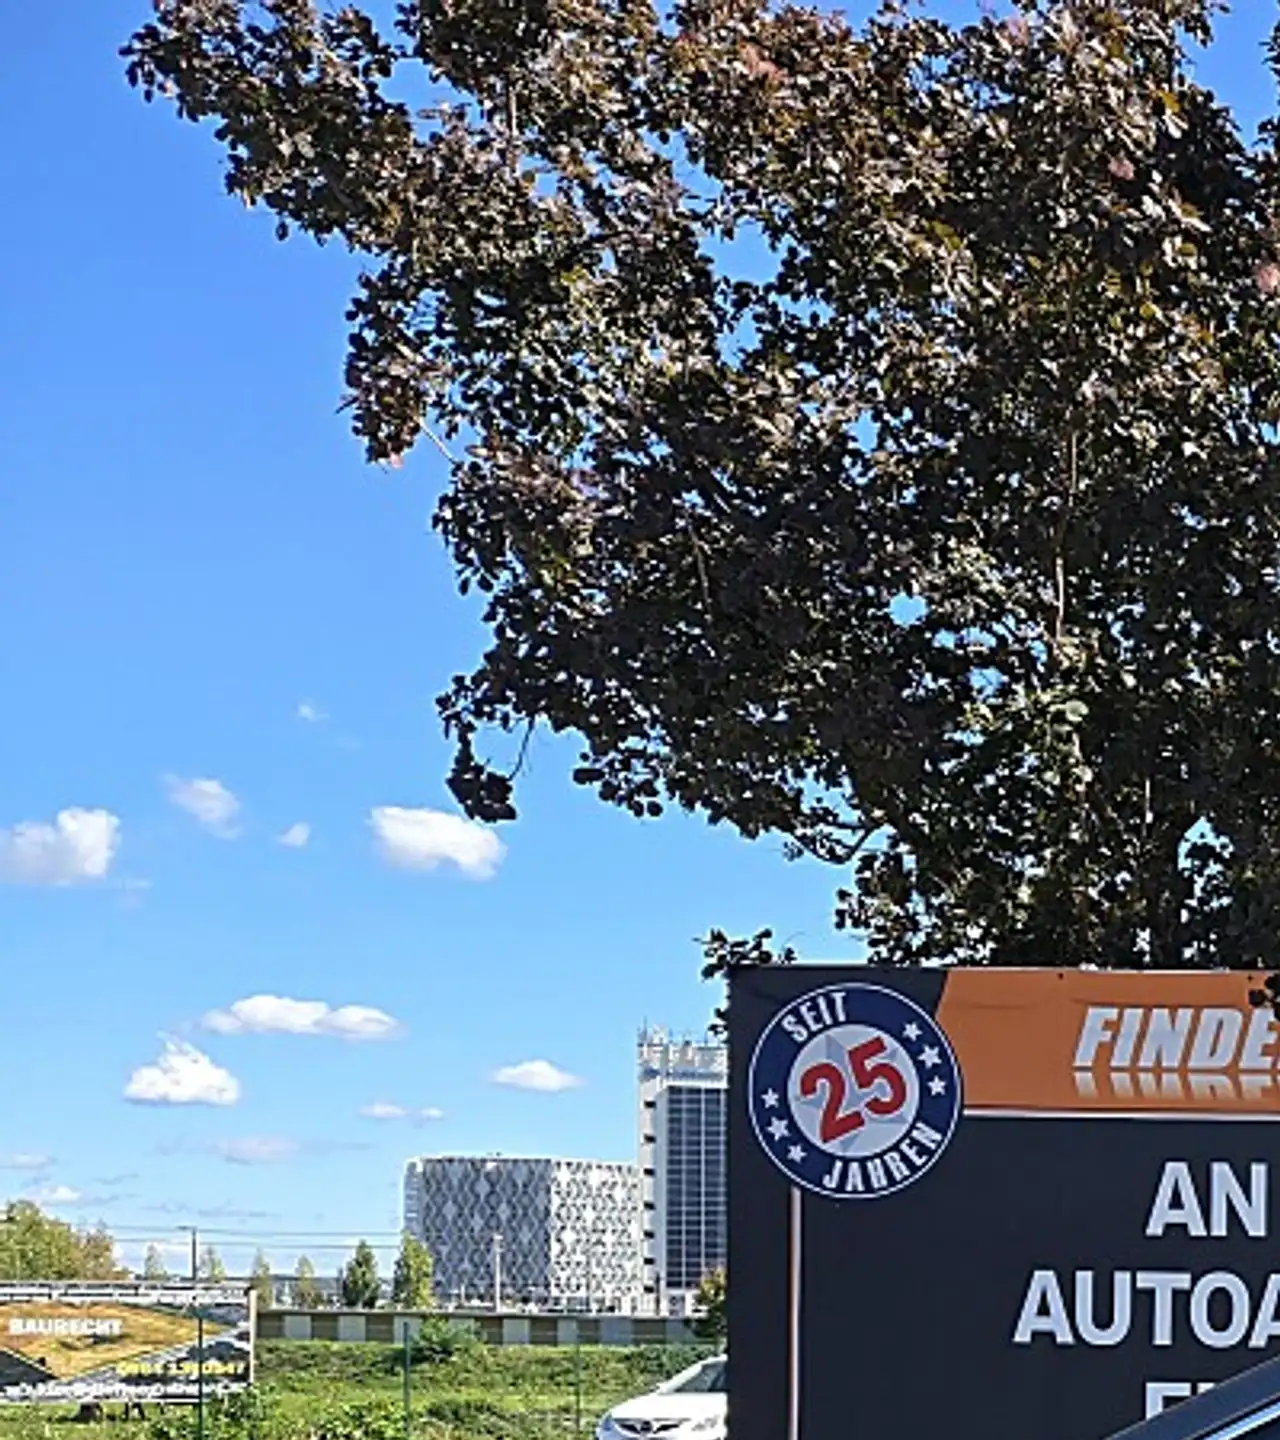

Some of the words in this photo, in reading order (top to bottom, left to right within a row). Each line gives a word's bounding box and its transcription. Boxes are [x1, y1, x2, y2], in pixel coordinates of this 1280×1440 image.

[781, 992, 847, 1042] SEIT
[800, 1036, 906, 1144] 25
[822, 1121, 943, 1192] JAHREN
[1145, 1161, 1268, 1238] AN
